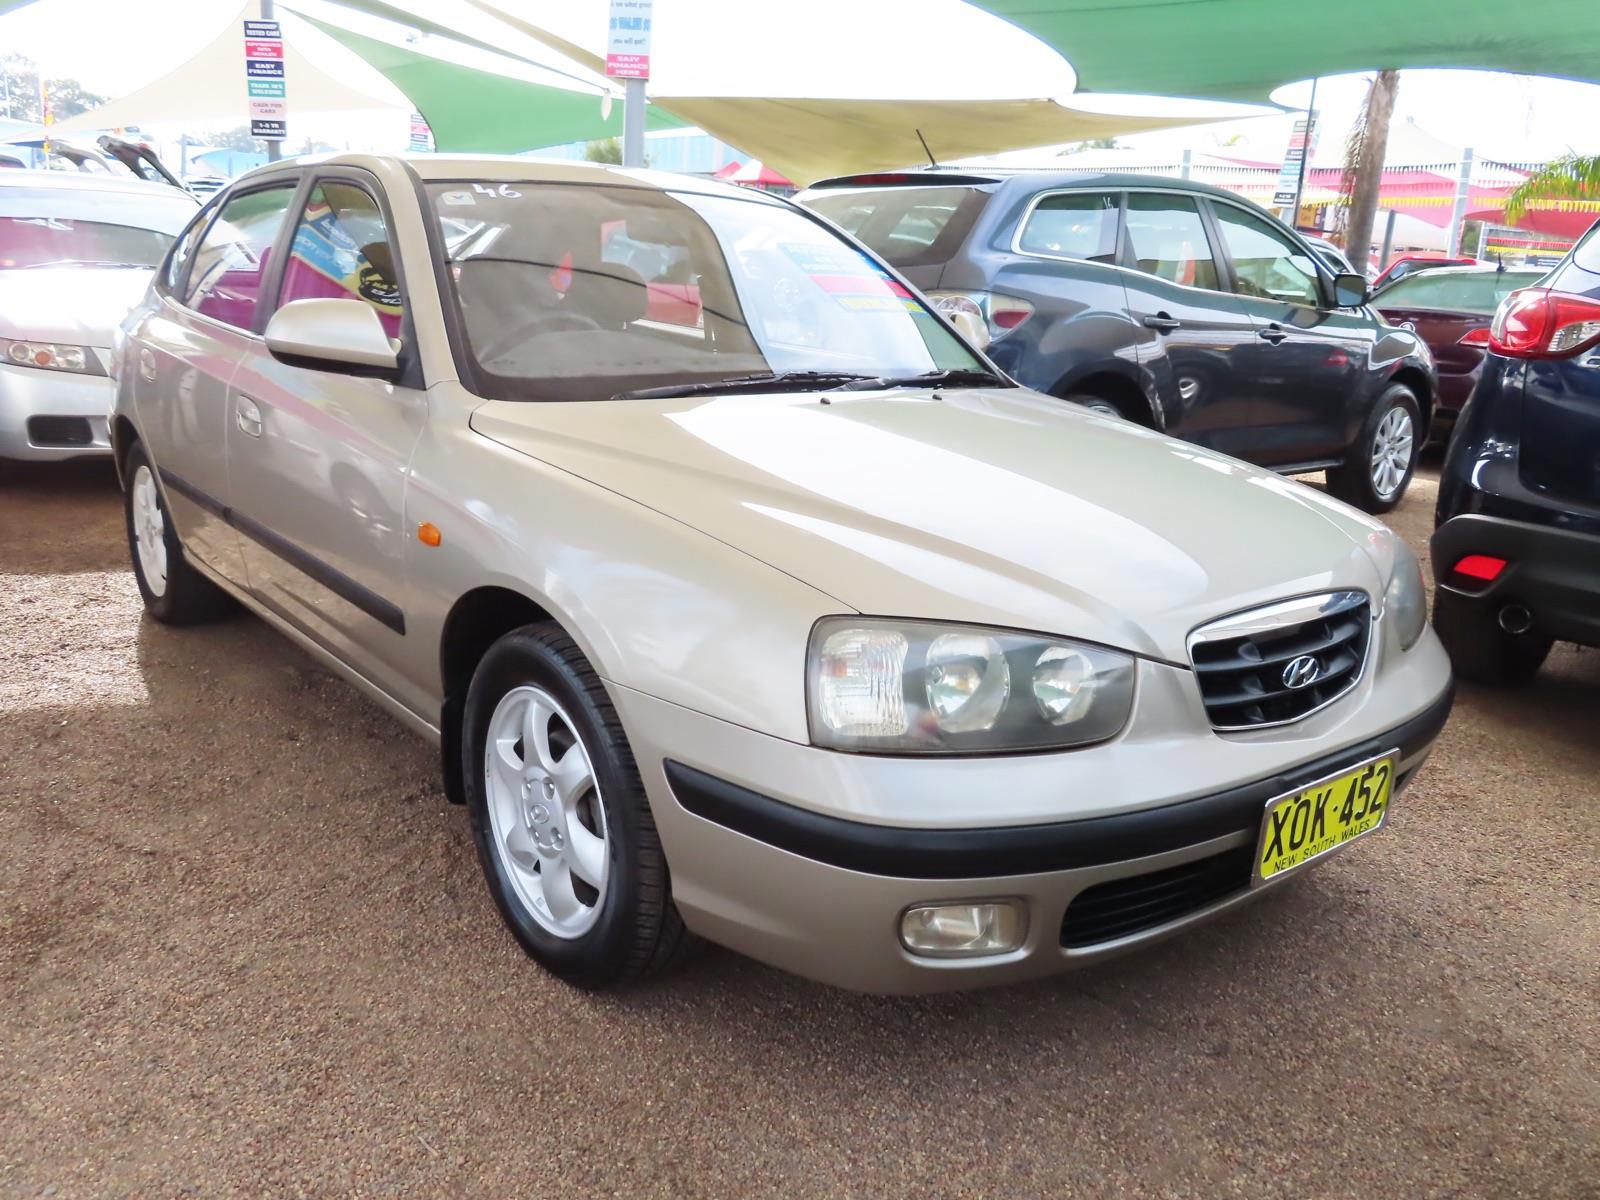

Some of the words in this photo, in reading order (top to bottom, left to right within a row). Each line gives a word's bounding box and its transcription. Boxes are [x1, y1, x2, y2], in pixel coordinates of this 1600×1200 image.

[472, 184, 522, 198] 46
[1274, 856, 1296, 872] NEW
[1303, 835, 1336, 860] SOUTH
[1341, 819, 1370, 840] WALES
